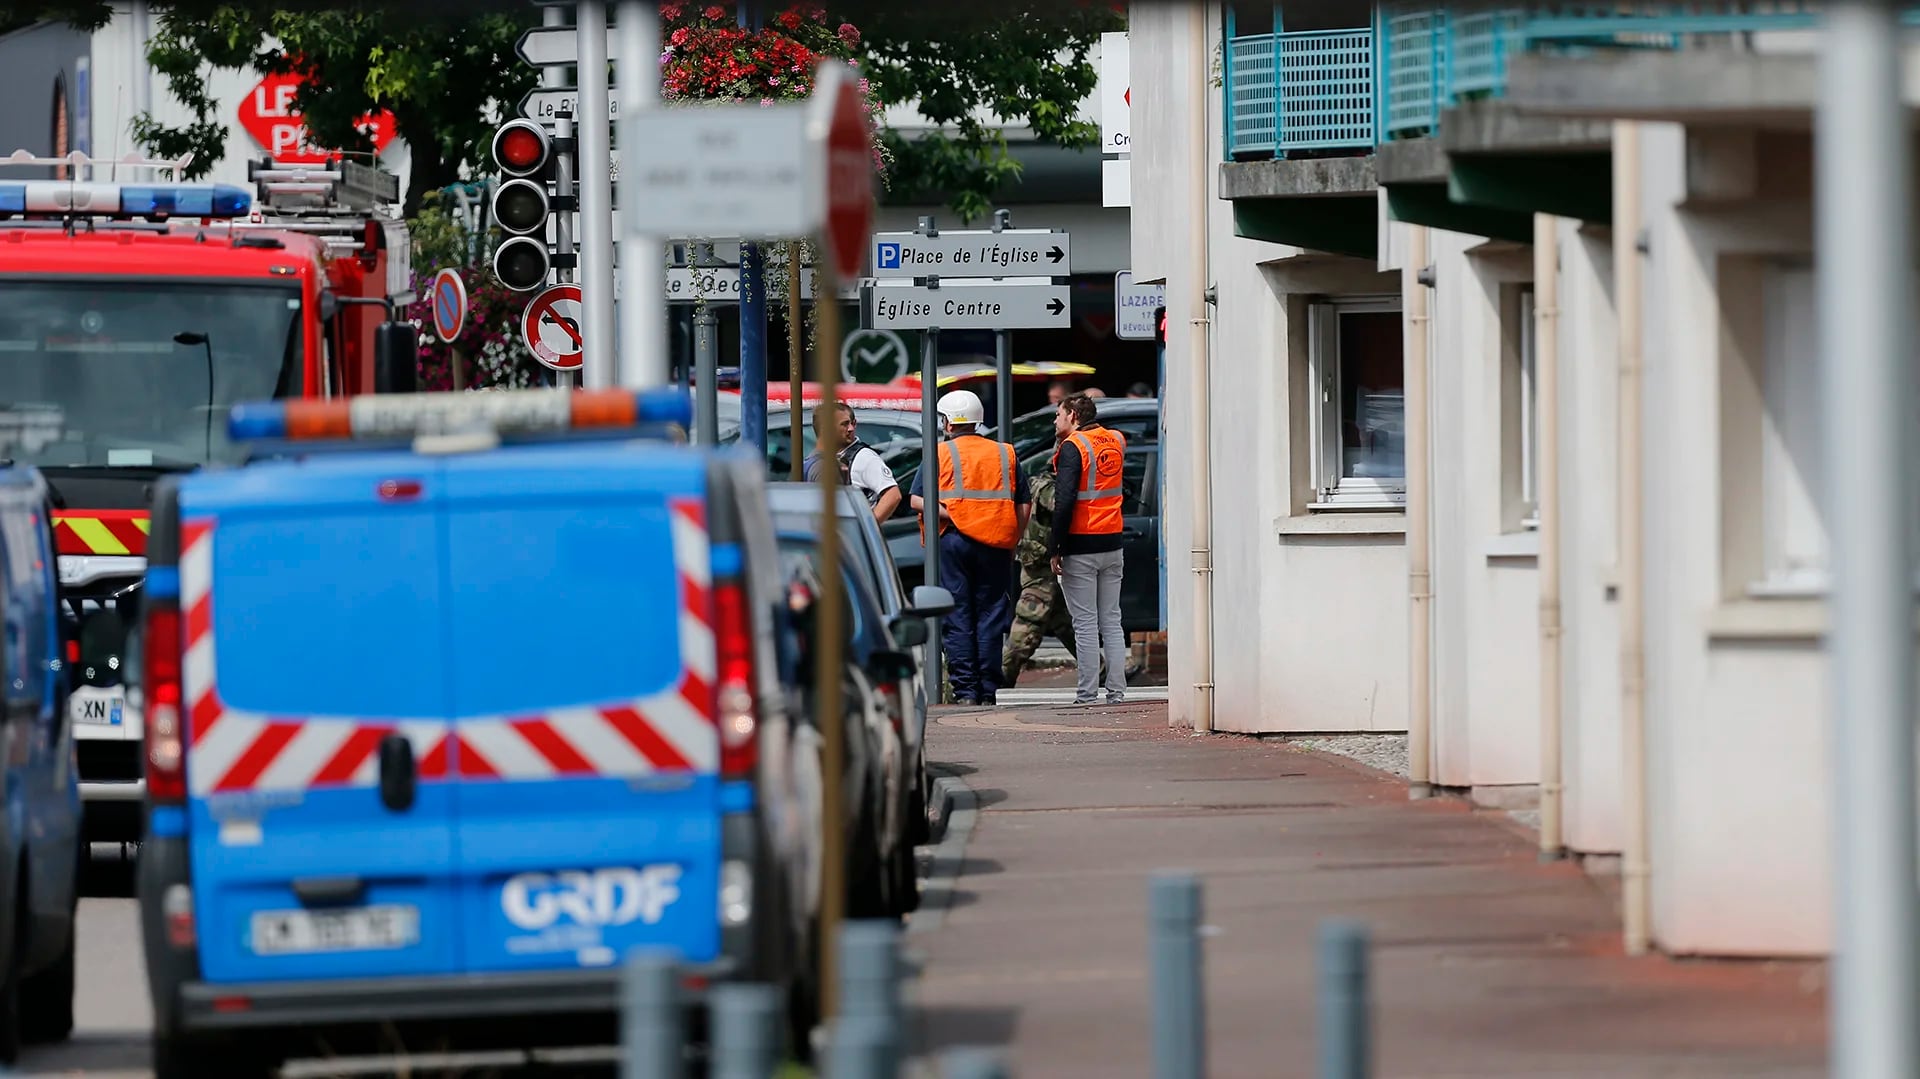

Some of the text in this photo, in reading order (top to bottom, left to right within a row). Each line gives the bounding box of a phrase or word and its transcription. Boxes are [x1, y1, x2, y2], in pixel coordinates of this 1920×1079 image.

[538, 99, 554, 117] Le
[881, 244, 1038, 267] P Place de l'Église
[877, 297, 1001, 320] Église Centre
[1121, 295, 1164, 307] LAZARE
[502, 863, 683, 930] GRDF
